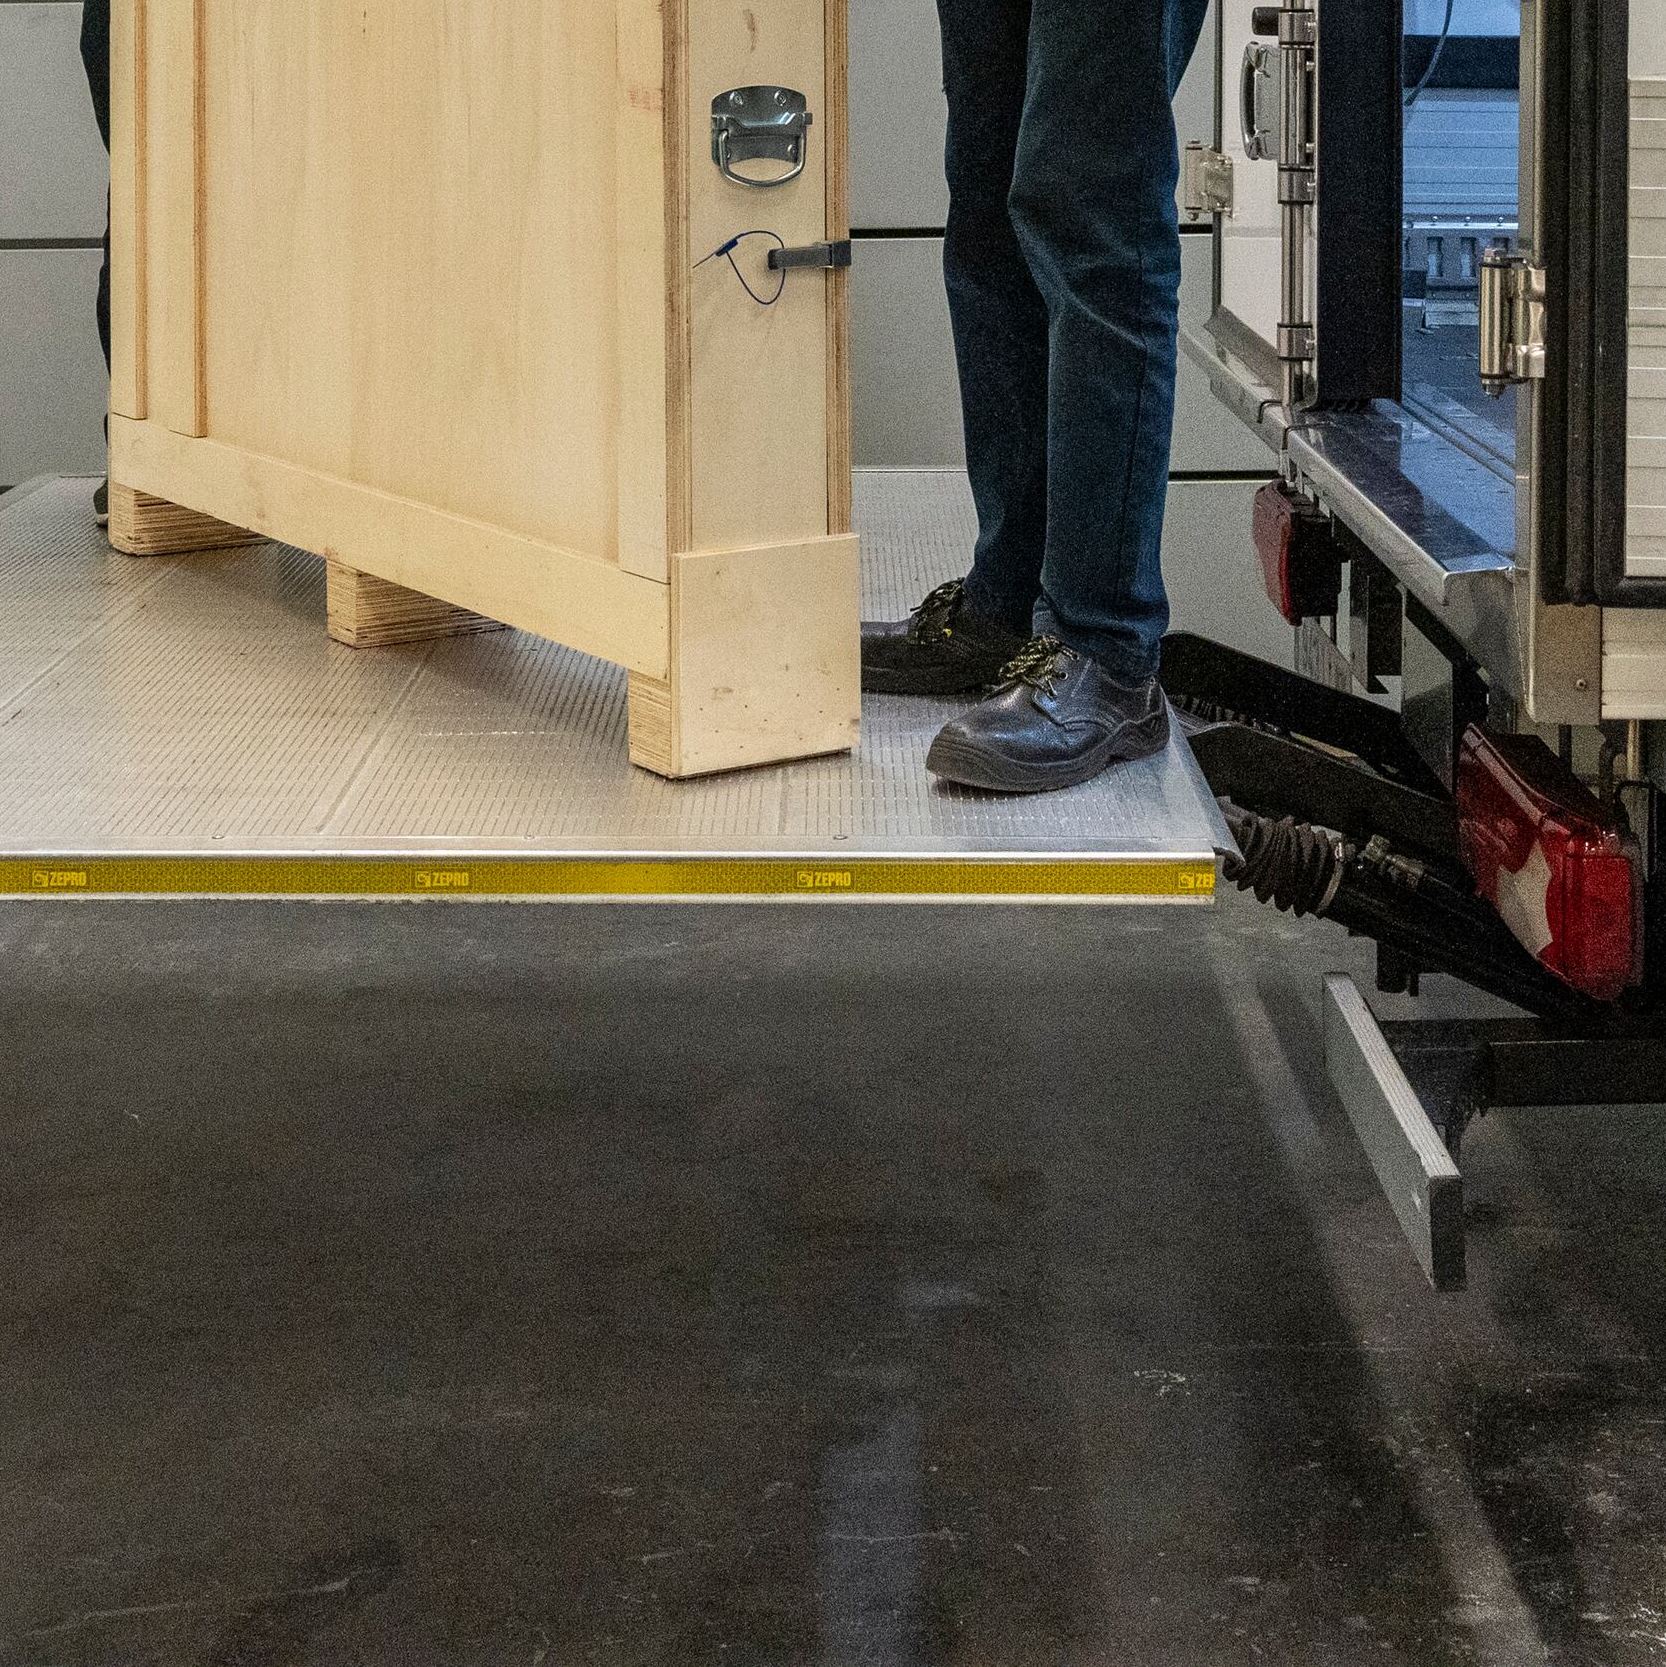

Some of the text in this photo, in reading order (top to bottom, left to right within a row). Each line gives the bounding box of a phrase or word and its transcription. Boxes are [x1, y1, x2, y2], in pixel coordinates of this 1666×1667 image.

[49, 871, 87, 887] ZEPRO
[432, 871, 470, 887] ZEPRO
[814, 871, 851, 887] ZEPRO
